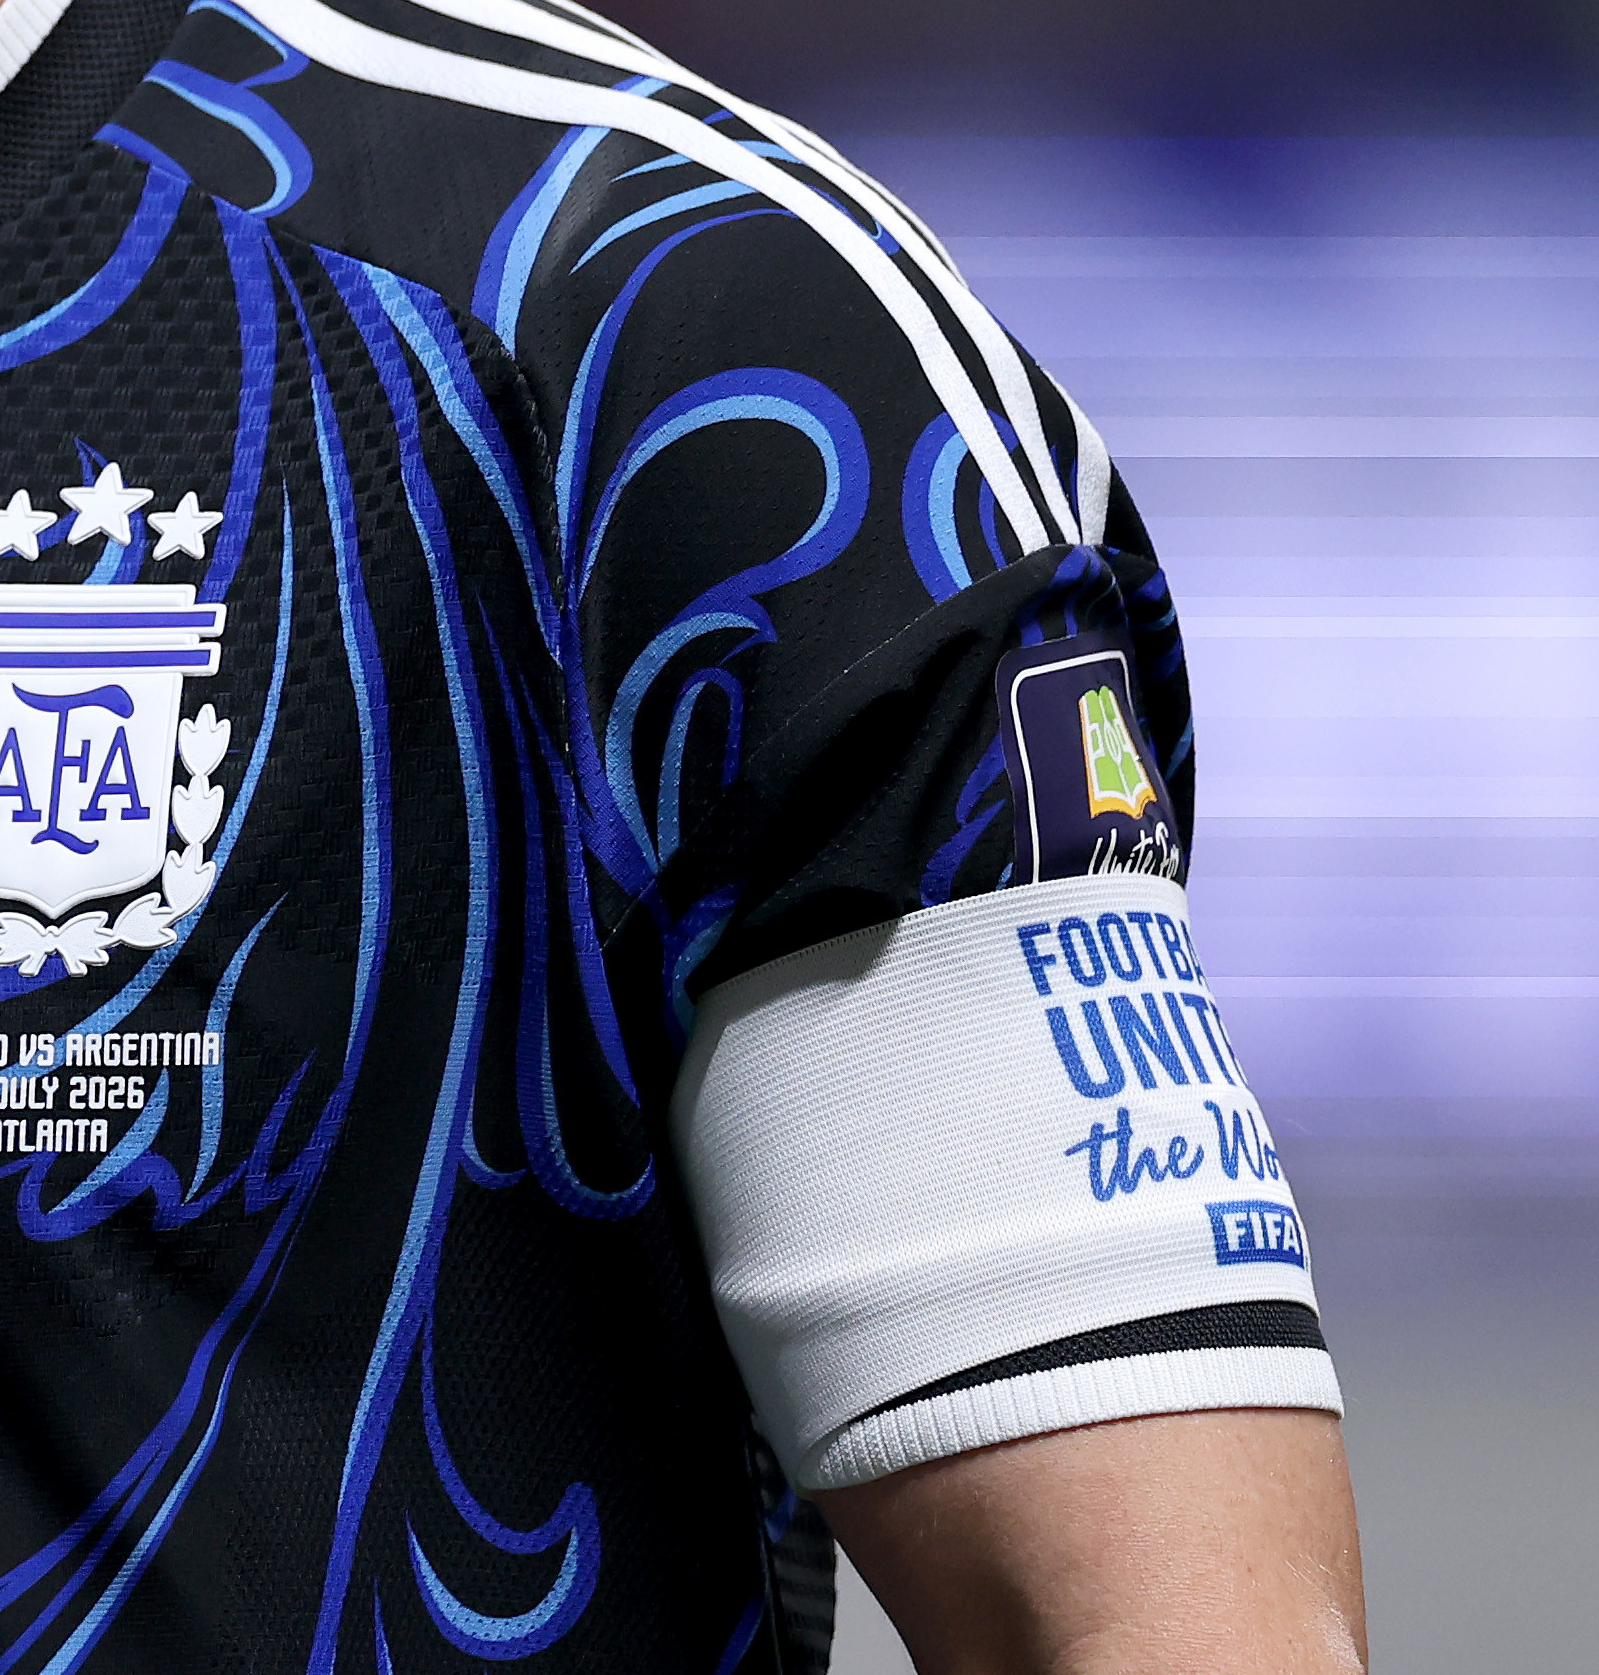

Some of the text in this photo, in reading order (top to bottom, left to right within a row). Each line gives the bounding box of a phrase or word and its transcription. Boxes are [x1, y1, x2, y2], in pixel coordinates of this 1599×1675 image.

[19, 1033, 55, 1067] VS
[65, 1031, 221, 1067] ARGENTINA
[69, 1075, 145, 1110] 2026
[1064, 1106, 1205, 1203] the
[1221, 1210, 1301, 1256] FIFA
